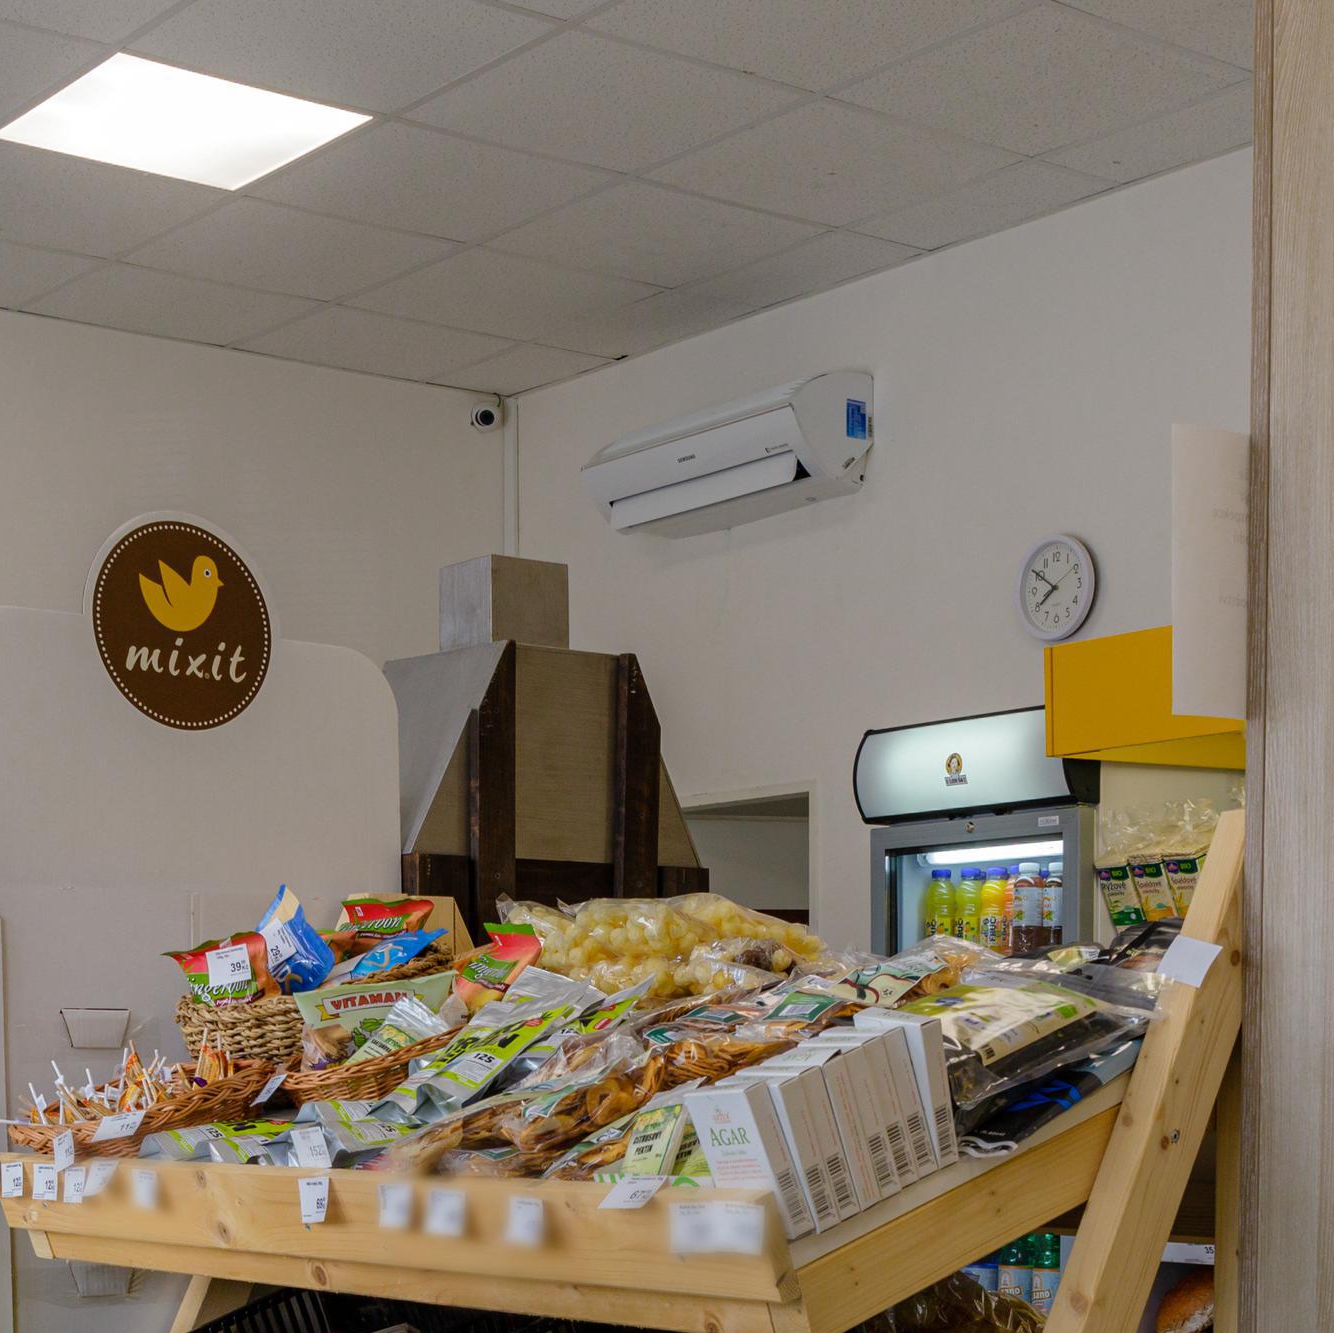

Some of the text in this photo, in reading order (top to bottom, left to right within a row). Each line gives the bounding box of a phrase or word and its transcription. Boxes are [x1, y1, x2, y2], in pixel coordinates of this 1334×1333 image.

[1052, 551, 1061, 563] 12
[1067, 553, 1070, 564] 1
[1043, 558, 1049, 569] 11
[1074, 563, 1080, 575] 2
[1035, 570, 1045, 582] 10
[1078, 577, 1083, 589] 3
[1032, 586, 1038, 597] 9
[1073, 595, 1078, 605] 4
[1035, 601, 1041, 613] 8
[1066, 607, 1071, 618] 5
[1045, 611, 1050, 622] 7
[1054, 613, 1060, 624] 6
[125, 638, 248, 684] mixit
[474, 1052, 496, 1065] 125
[710, 1127, 751, 1148] AGAR
